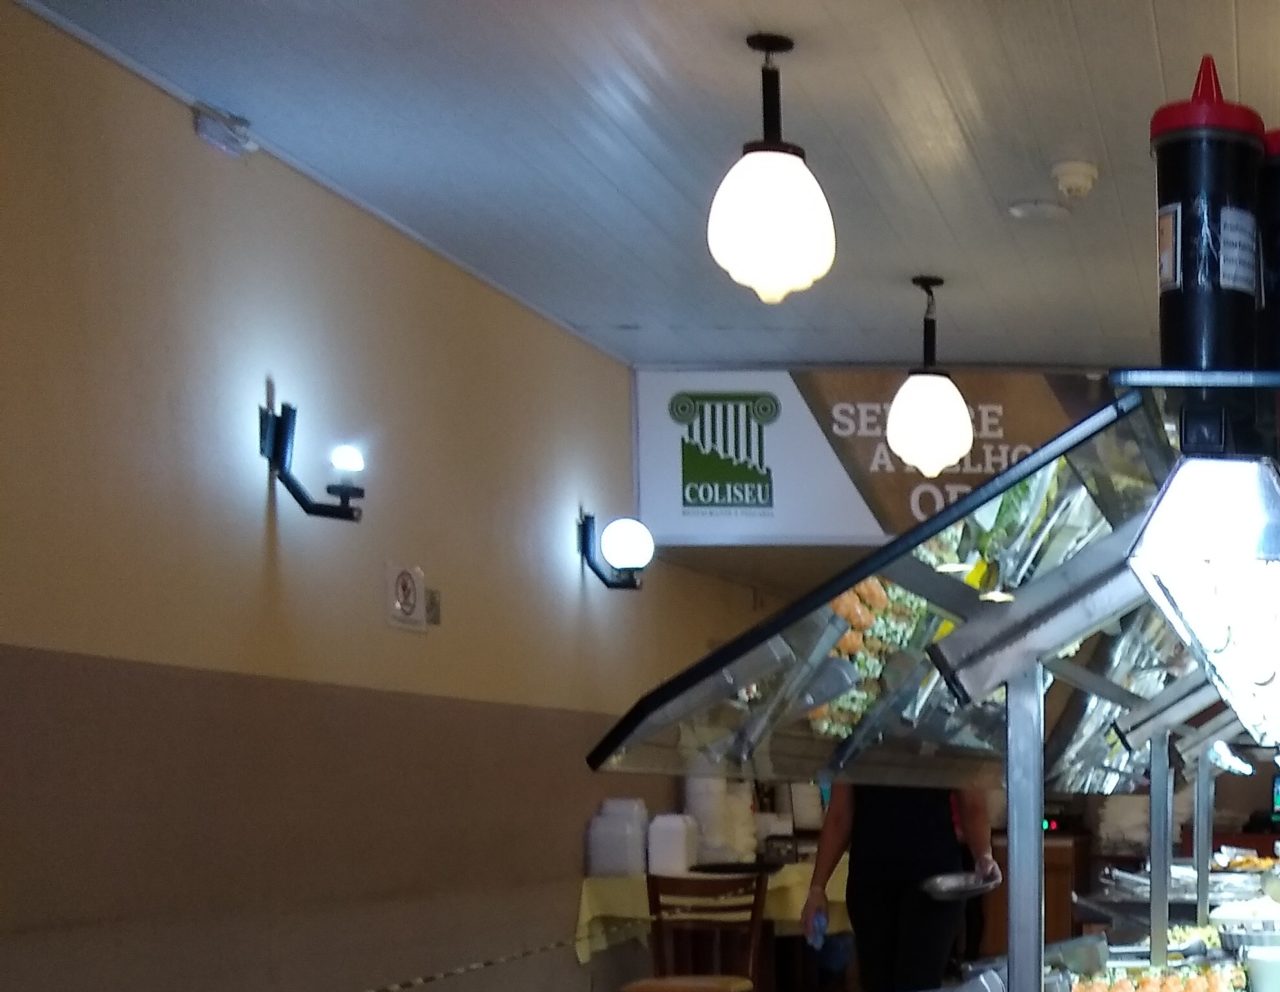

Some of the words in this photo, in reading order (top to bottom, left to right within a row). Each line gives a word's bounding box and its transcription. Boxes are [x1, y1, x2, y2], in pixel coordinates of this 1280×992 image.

[831, 402, 1004, 439] SEE
[870, 442, 895, 473] A
[684, 482, 770, 504] COLISEU
